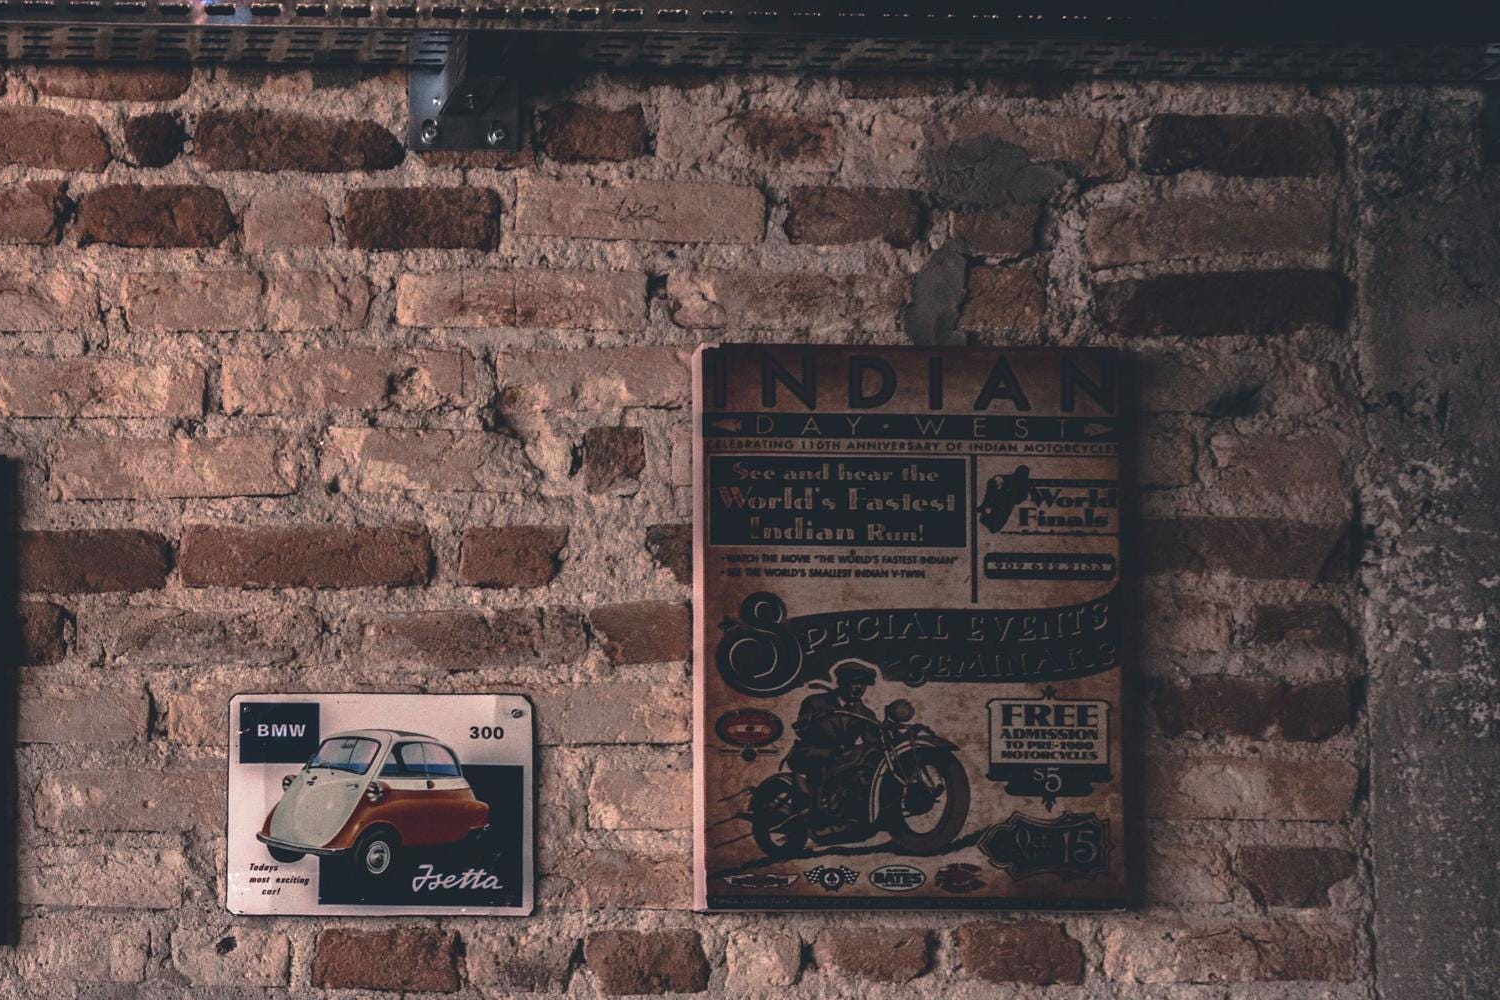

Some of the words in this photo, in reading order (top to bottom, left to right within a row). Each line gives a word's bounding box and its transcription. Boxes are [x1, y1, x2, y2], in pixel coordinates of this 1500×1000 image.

[711, 354, 1115, 414] INDIAN
[756, 416, 862, 435] DAY
[915, 417, 1069, 438] WEST
[707, 440, 793, 449] CELEBRATING
[801, 441, 840, 450] 110TH
[846, 441, 942, 451] ANNIVERSARY
[946, 442, 963, 450] OF
[969, 442, 1018, 452] INDIAN
[732, 462, 776, 480] See
[783, 463, 830, 481] and
[838, 463, 893, 481] hear
[902, 464, 940, 482] the
[717, 486, 837, 511] World's
[848, 487, 956, 512] Fastest
[1029, 489, 1117, 507] World
[1019, 508, 1109, 527] Finals
[750, 516, 855, 541] Indian
[867, 522, 924, 542] Run!
[716, 592, 950, 698] SPECIAL
[966, 602, 1111, 641] EVENTS
[1000, 704, 1099, 727] FREE
[257, 724, 306, 738] BMW
[469, 726, 505, 740] 300
[1000, 729, 1099, 740] ADMISSION
[1004, 741, 1025, 750] TO
[1001, 750, 1099, 760] MOTORCYCLES
[1061, 829, 1099, 864] 15
[249, 863, 279, 873] Todays
[275, 875, 310, 886] exciting
[412, 863, 504, 893] Isetta
[261, 887, 281, 895] car!
